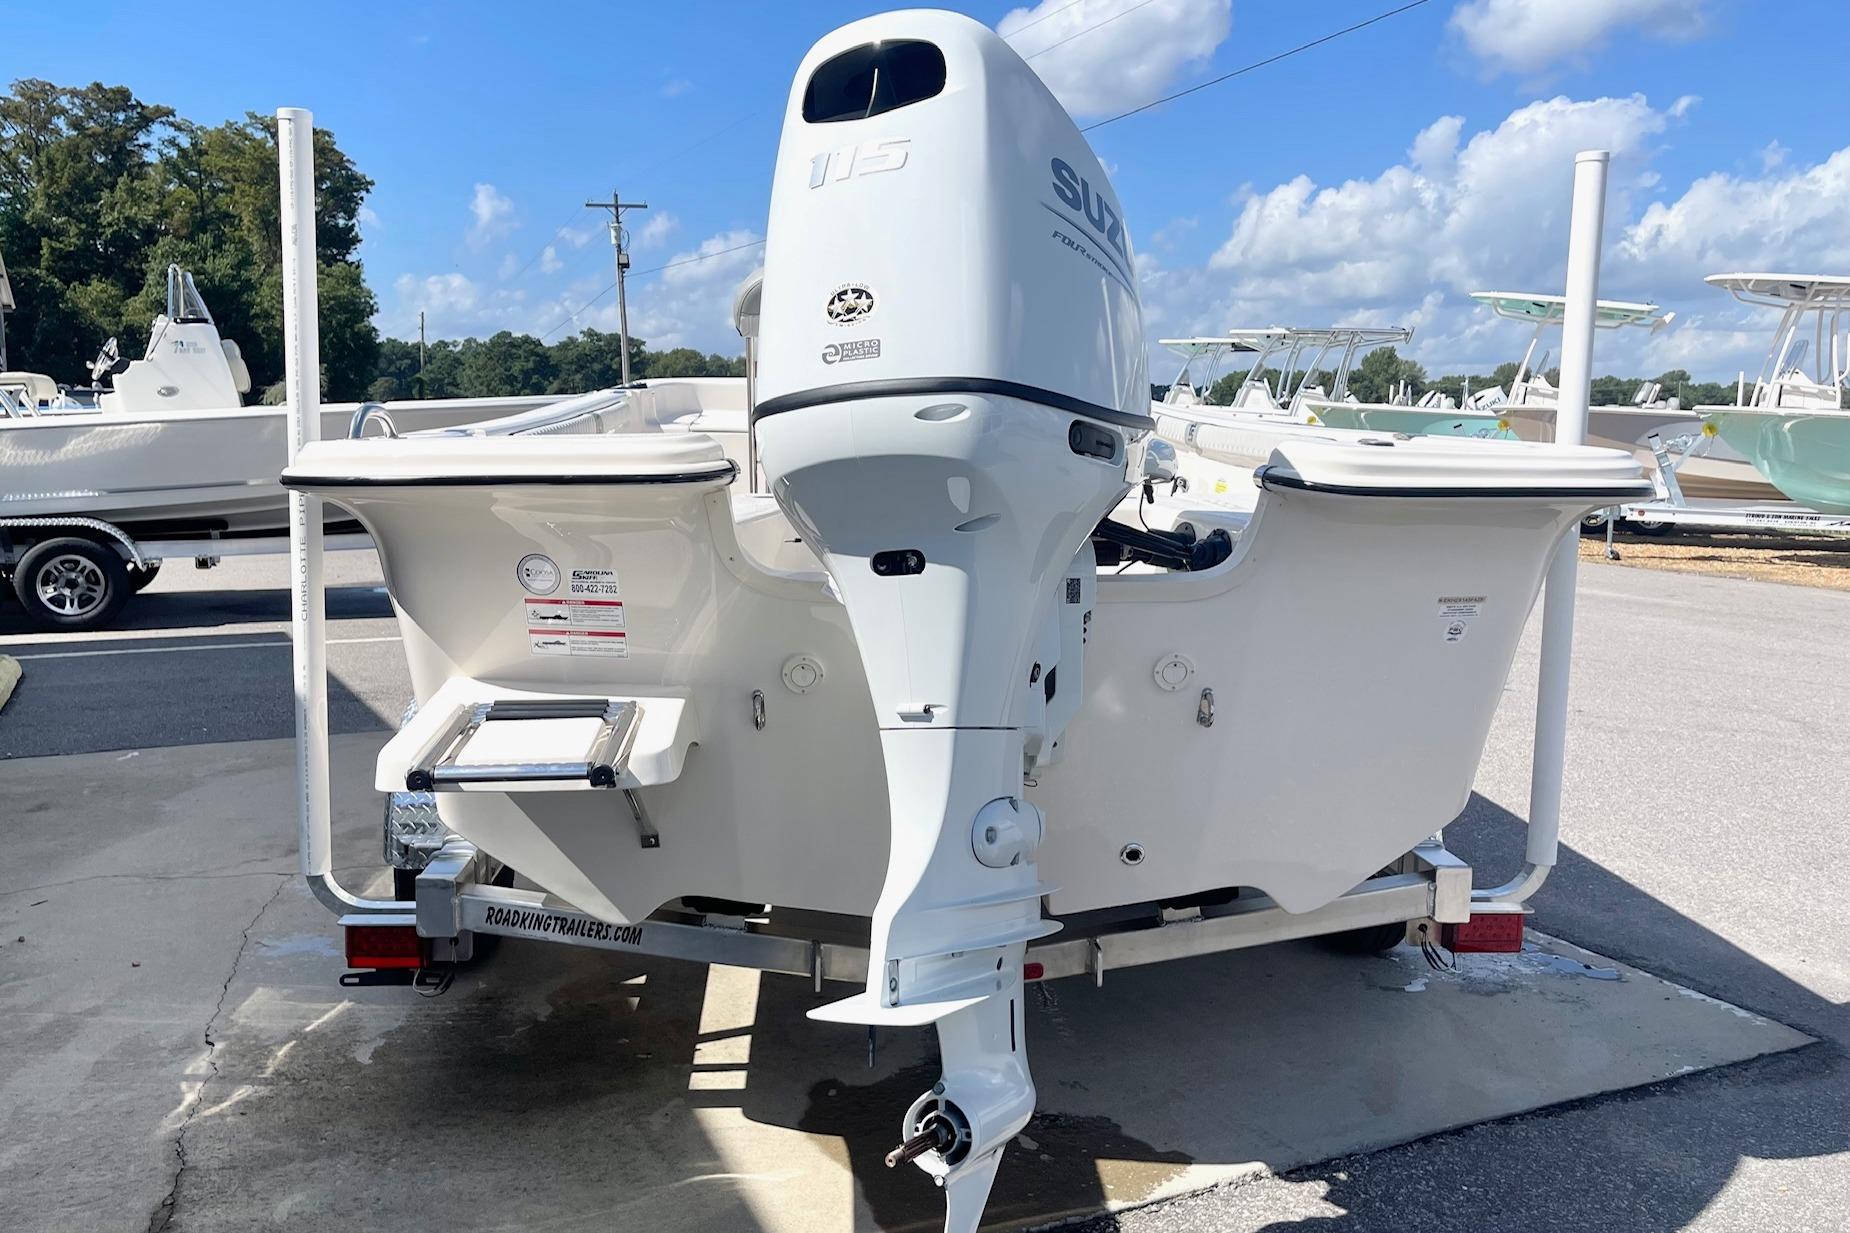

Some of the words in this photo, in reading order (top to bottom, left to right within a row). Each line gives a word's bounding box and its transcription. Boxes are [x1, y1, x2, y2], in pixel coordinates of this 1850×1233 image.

[808, 138, 911, 190] 115
[1051, 157, 1131, 274] SUZ
[1052, 230, 1087, 257] FOUR
[842, 346, 879, 357] PLASTIC
[843, 340, 879, 350] MICRO
[300, 537, 308, 622] CHARLOTTE
[571, 584, 618, 593] 800-422-7282
[485, 906, 643, 946] ROADKINGTRAILERS.COM
